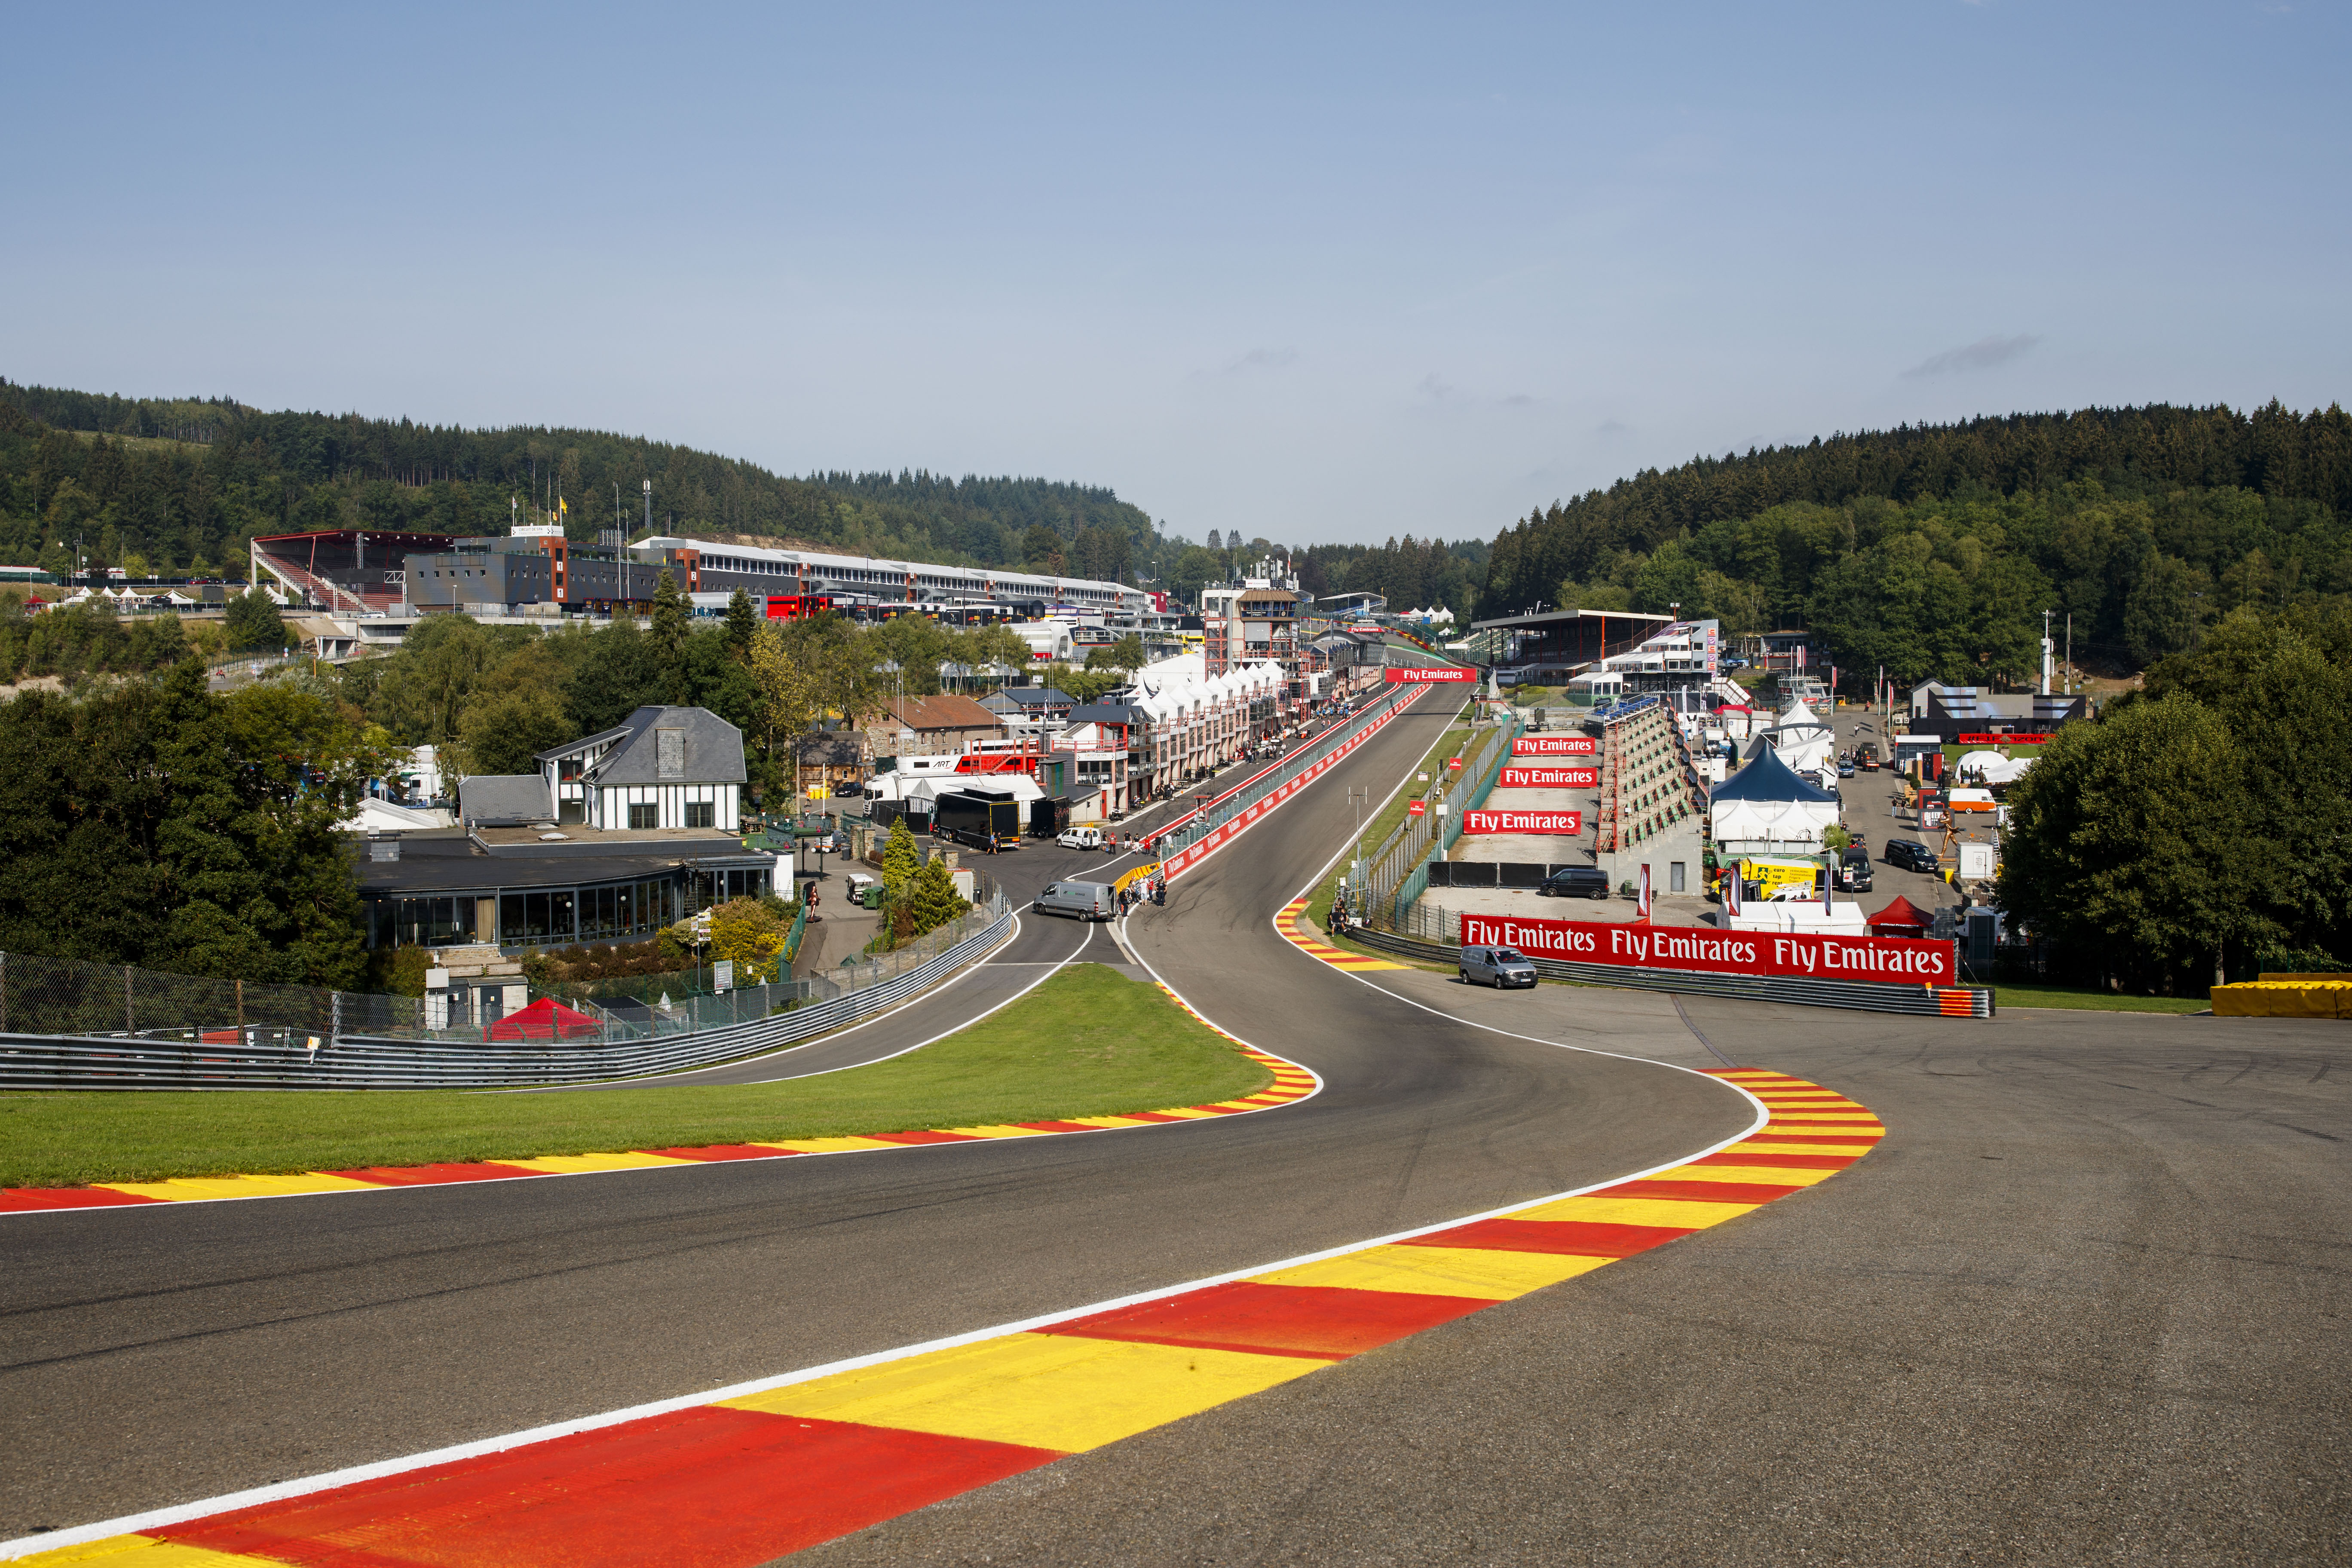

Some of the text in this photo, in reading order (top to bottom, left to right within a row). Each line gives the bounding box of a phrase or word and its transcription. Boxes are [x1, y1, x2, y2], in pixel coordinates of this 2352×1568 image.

[1404, 670, 1463, 680] Fly Emirates
[1517, 739, 1591, 753] Fly Emirates
[1506, 770, 1592, 784] Fly Emirates
[1232, 819, 1240, 830] Emirates
[1470, 813, 1575, 831] Fly Emirates
[1211, 832, 1221, 845] Emirates
[1194, 844, 1204, 857] Emirates
[1173, 856, 1184, 871] Emirates
[1468, 920, 1595, 951] Fly Emirates
[1611, 930, 1755, 962] Fly Emirates
[1774, 939, 1944, 974] Fly Emirates
